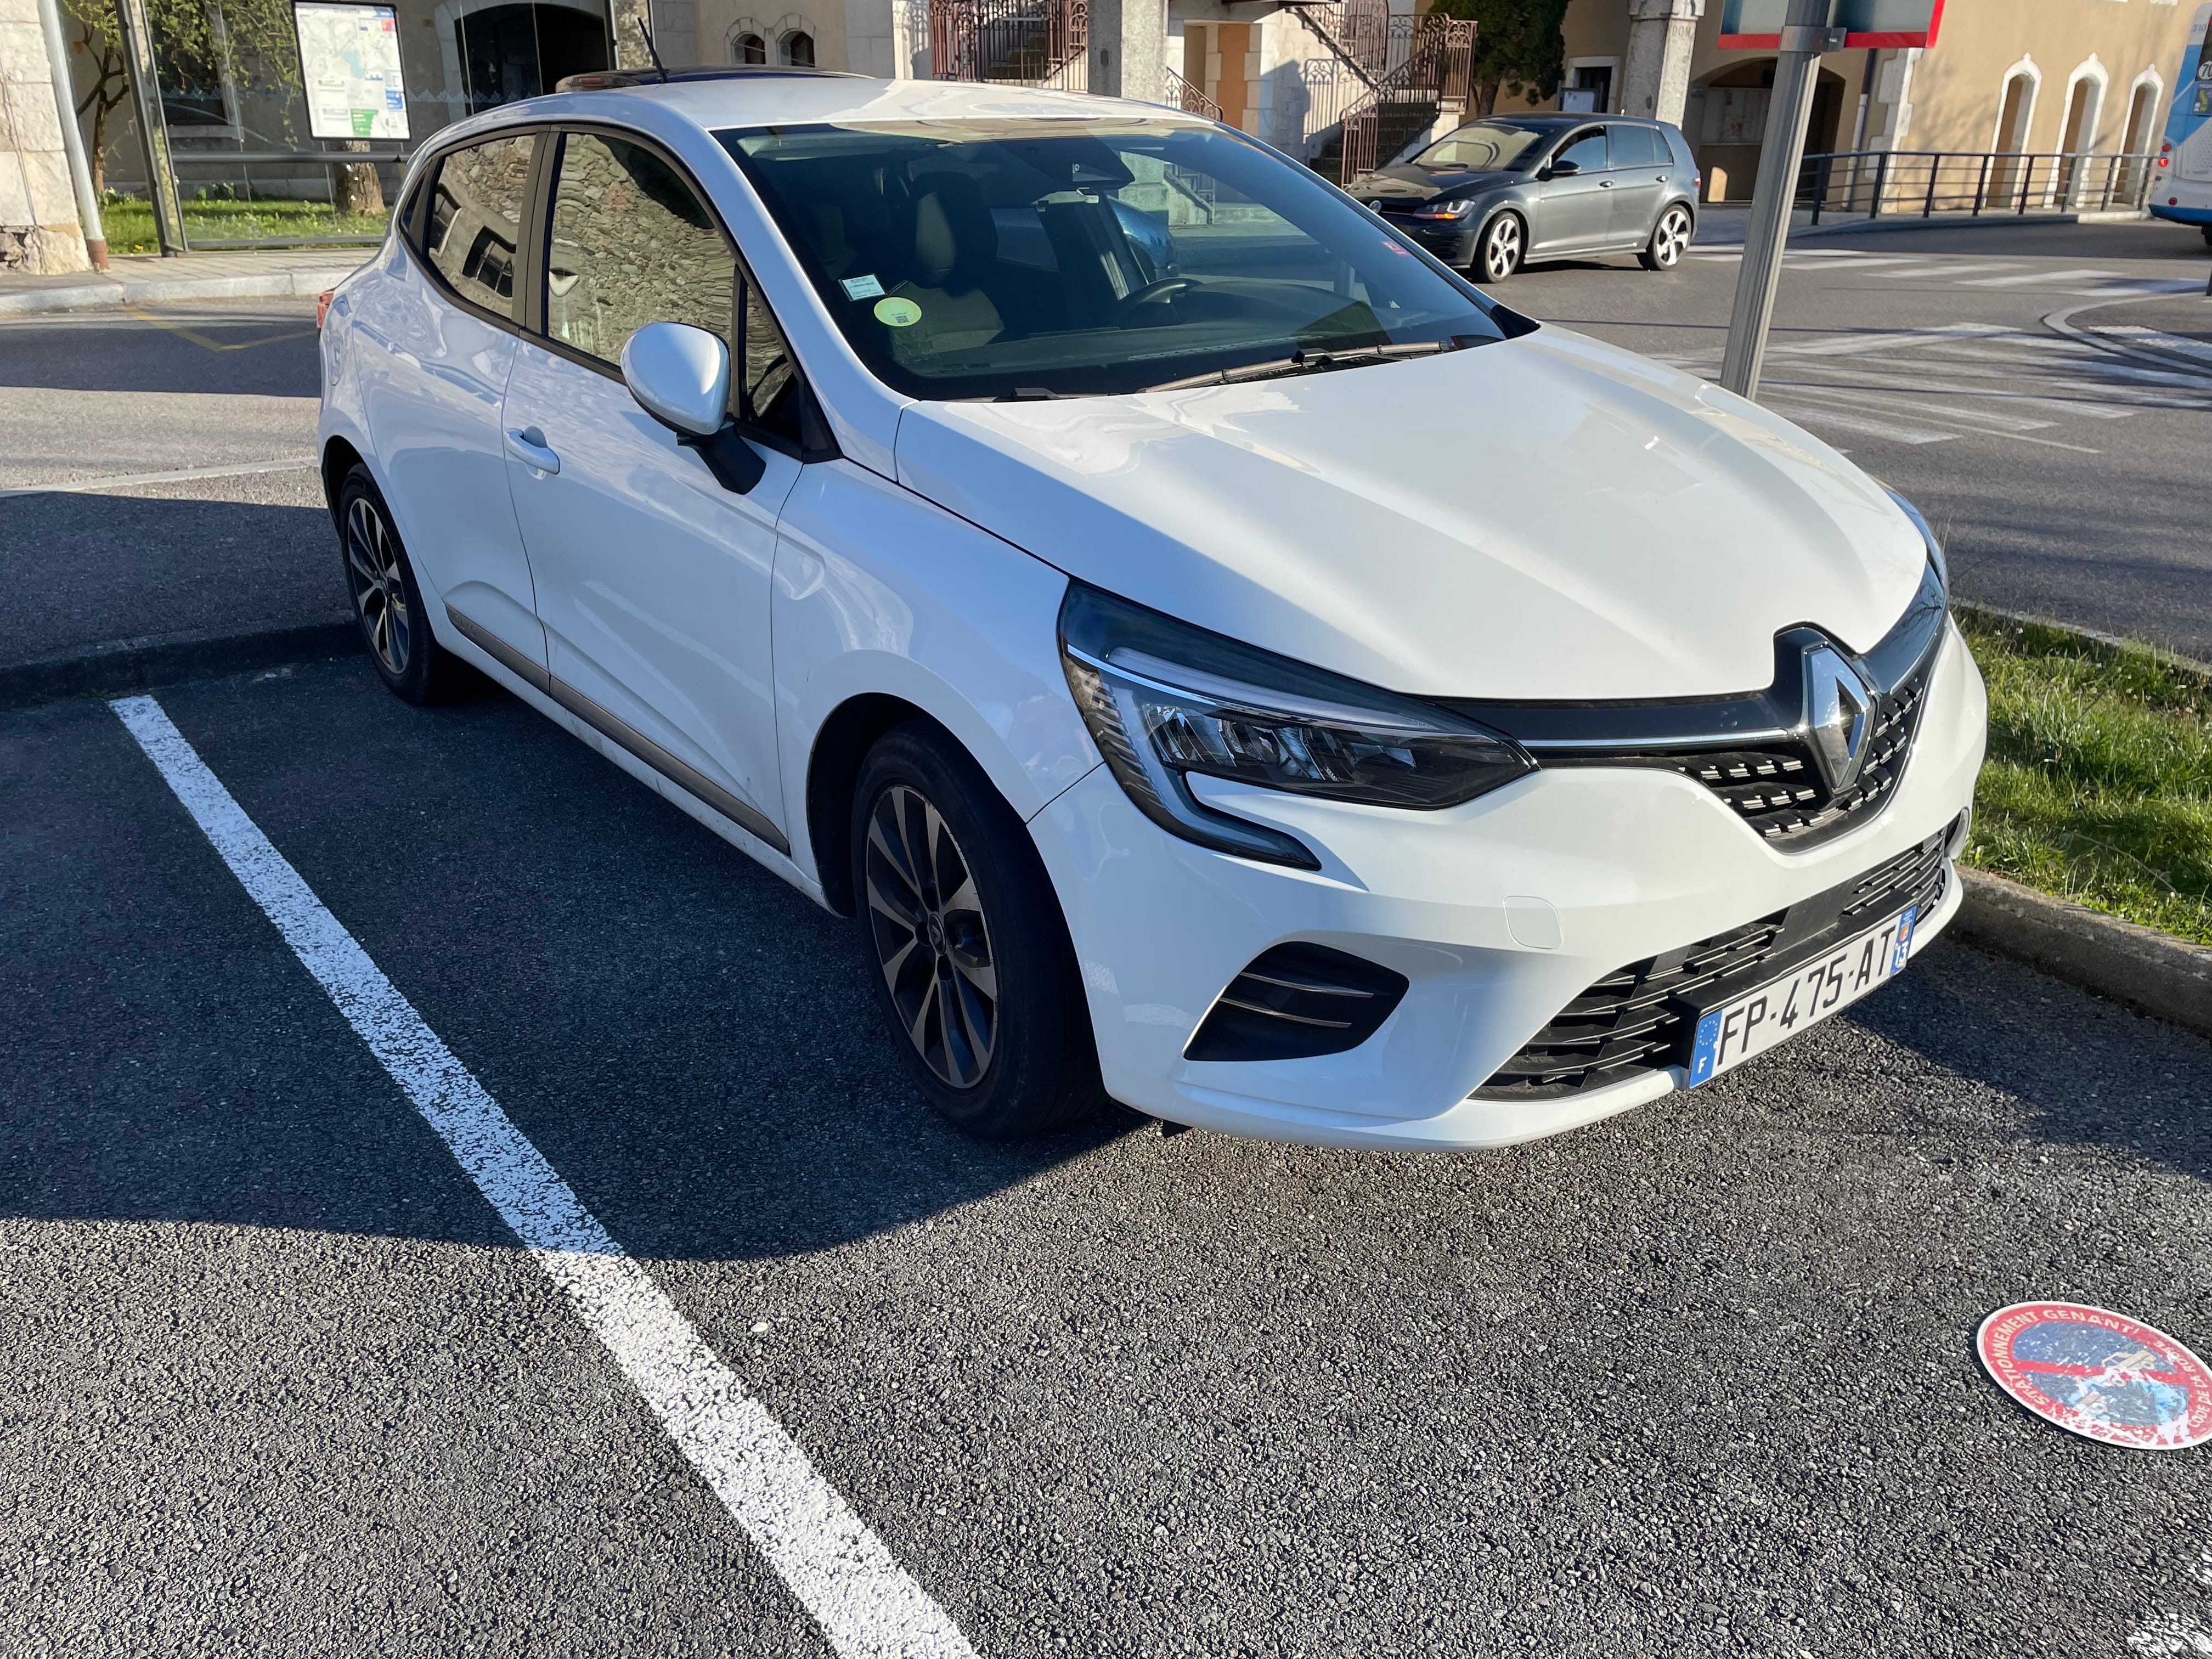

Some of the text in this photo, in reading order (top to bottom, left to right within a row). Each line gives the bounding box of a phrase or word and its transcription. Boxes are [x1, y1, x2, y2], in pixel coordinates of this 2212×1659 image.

[1717, 924, 1896, 1066] FP-475-AT
[1895, 940, 1909, 967] 13
[1697, 1056, 1707, 1074] F
[1992, 1311, 2050, 1406] STATIONNEMENT
[2153, 1340, 2212, 1429] CODE DE LA ROUTE
